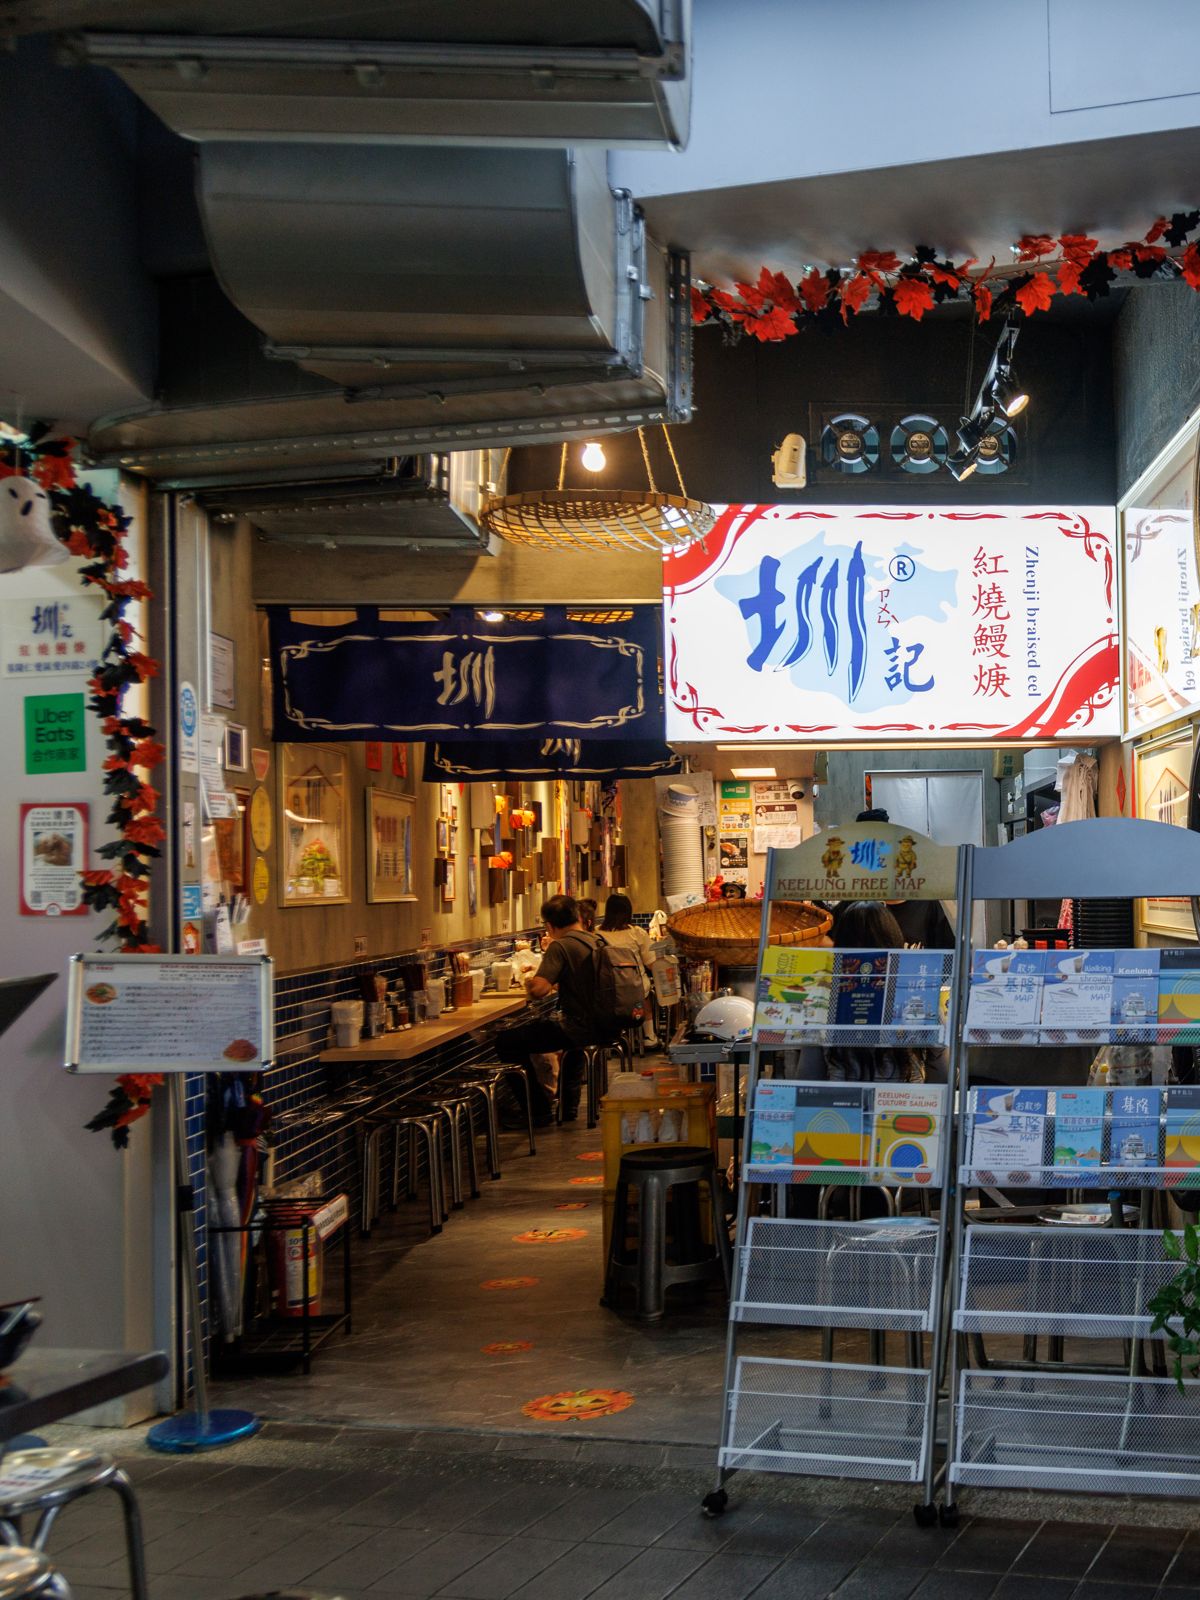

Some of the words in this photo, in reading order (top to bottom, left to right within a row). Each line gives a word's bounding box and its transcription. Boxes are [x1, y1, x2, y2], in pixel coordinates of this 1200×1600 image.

[1023, 546, 1040, 601] Zhenji
[1026, 607, 1041, 668] braised
[1027, 675, 1042, 697] eel
[34, 708, 75, 724] Uber
[35, 727, 75, 743] Eats
[777, 878, 847, 891] KEELUNG
[851, 878, 889, 890] FREE
[894, 877, 926, 890] MAP
[1118, 967, 1153, 976] Keelung
[877, 1091, 910, 1100] KEELUNG
[877, 1099, 907, 1107] CULTURE
[909, 1100, 938, 1108] SAILING
